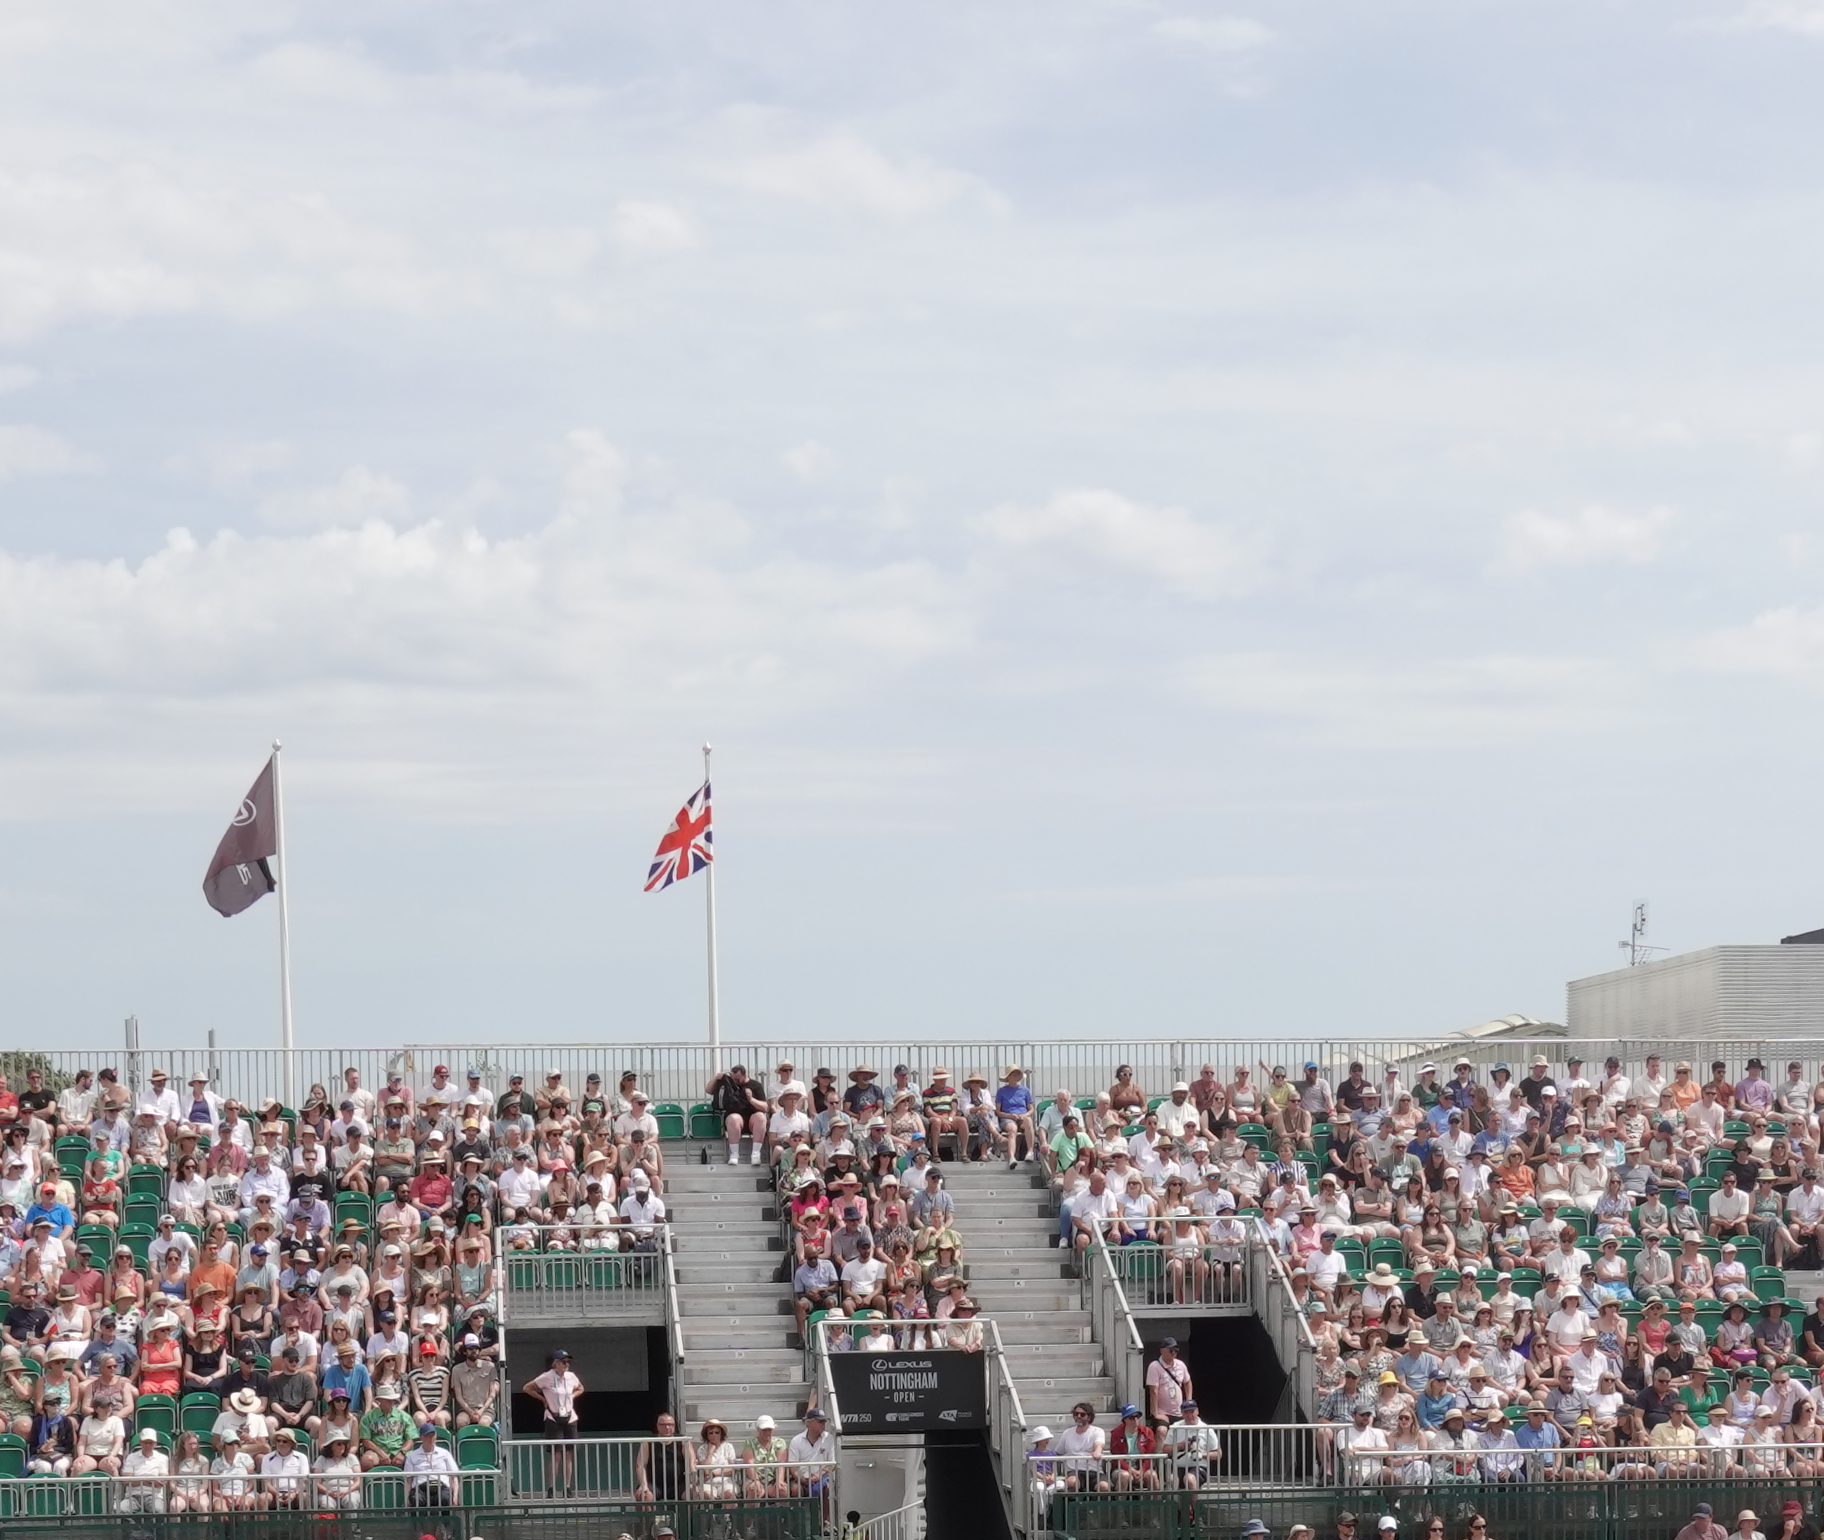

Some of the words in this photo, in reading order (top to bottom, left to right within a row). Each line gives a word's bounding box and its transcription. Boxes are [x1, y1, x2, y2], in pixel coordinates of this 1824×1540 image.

[888, 1360, 933, 1369] LEXUS
[869, 1372, 938, 1390] NOTTINGHAM
[893, 1391, 916, 1403] OPEN
[859, 1413, 872, 1423] 250
